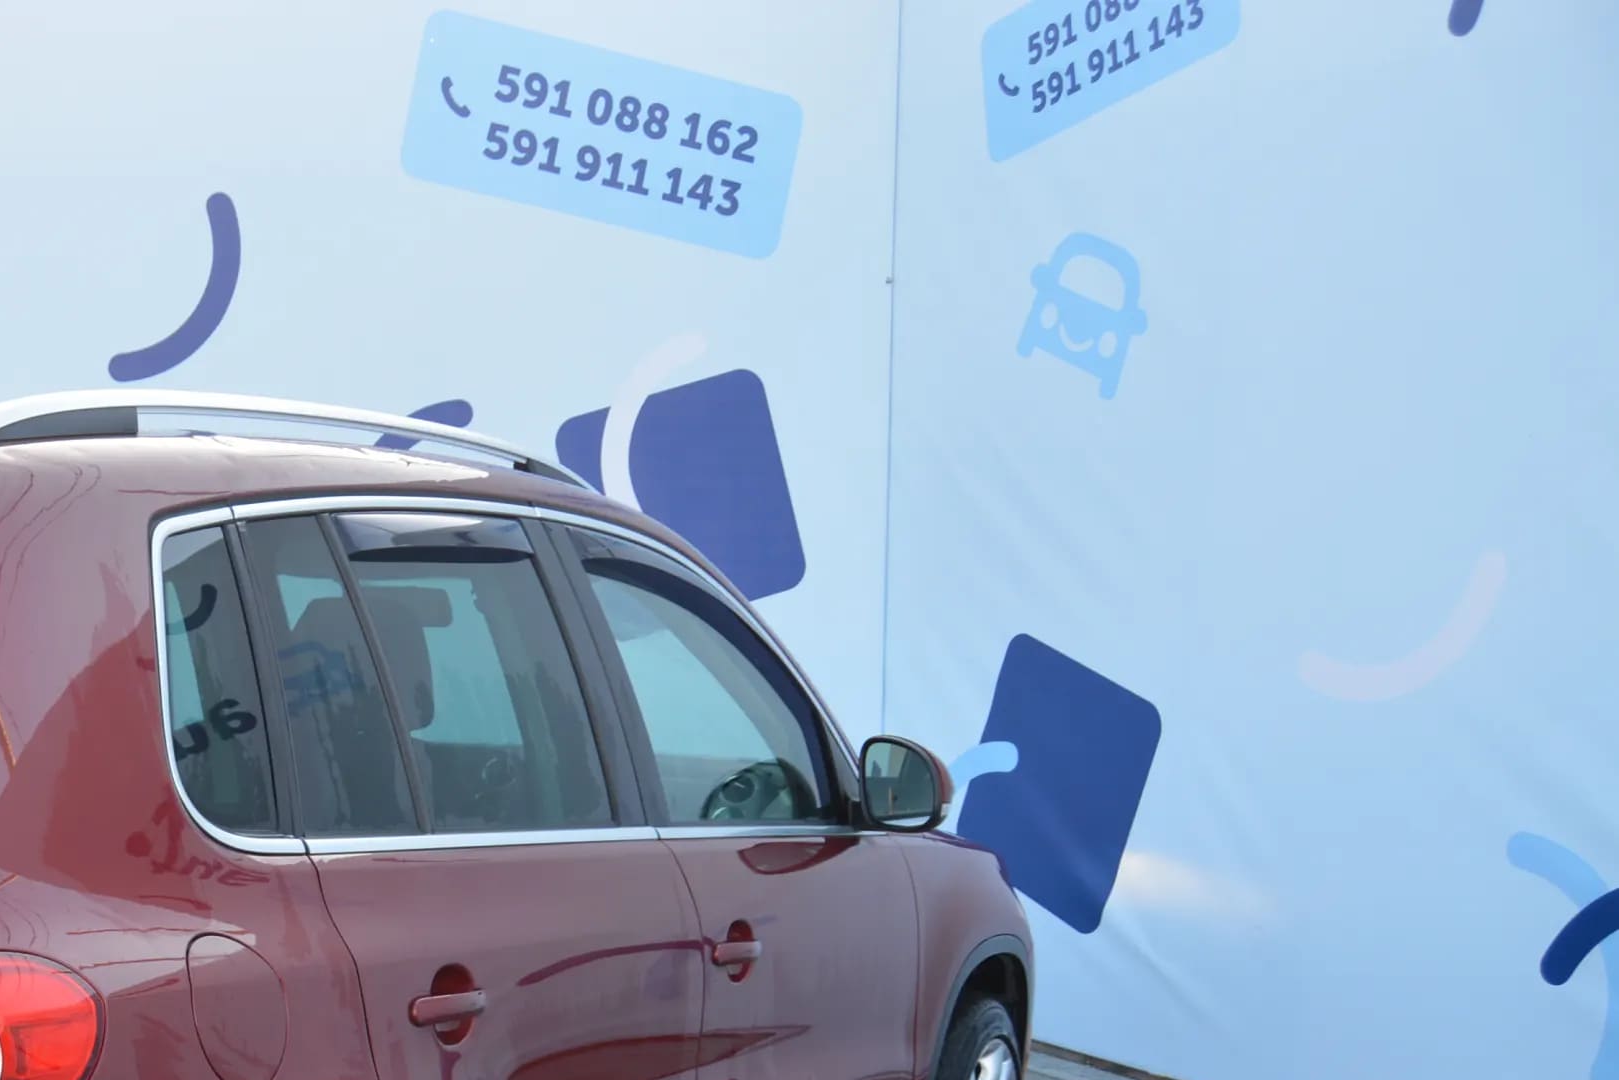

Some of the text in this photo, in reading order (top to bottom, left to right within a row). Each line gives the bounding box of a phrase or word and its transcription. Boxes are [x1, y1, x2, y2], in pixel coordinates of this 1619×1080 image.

[1028, 13, 1077, 65] 591
[1032, 0, 1204, 113] 591 911 143
[494, 64, 758, 164] 591 088 162
[482, 122, 742, 217] 591 911 143
